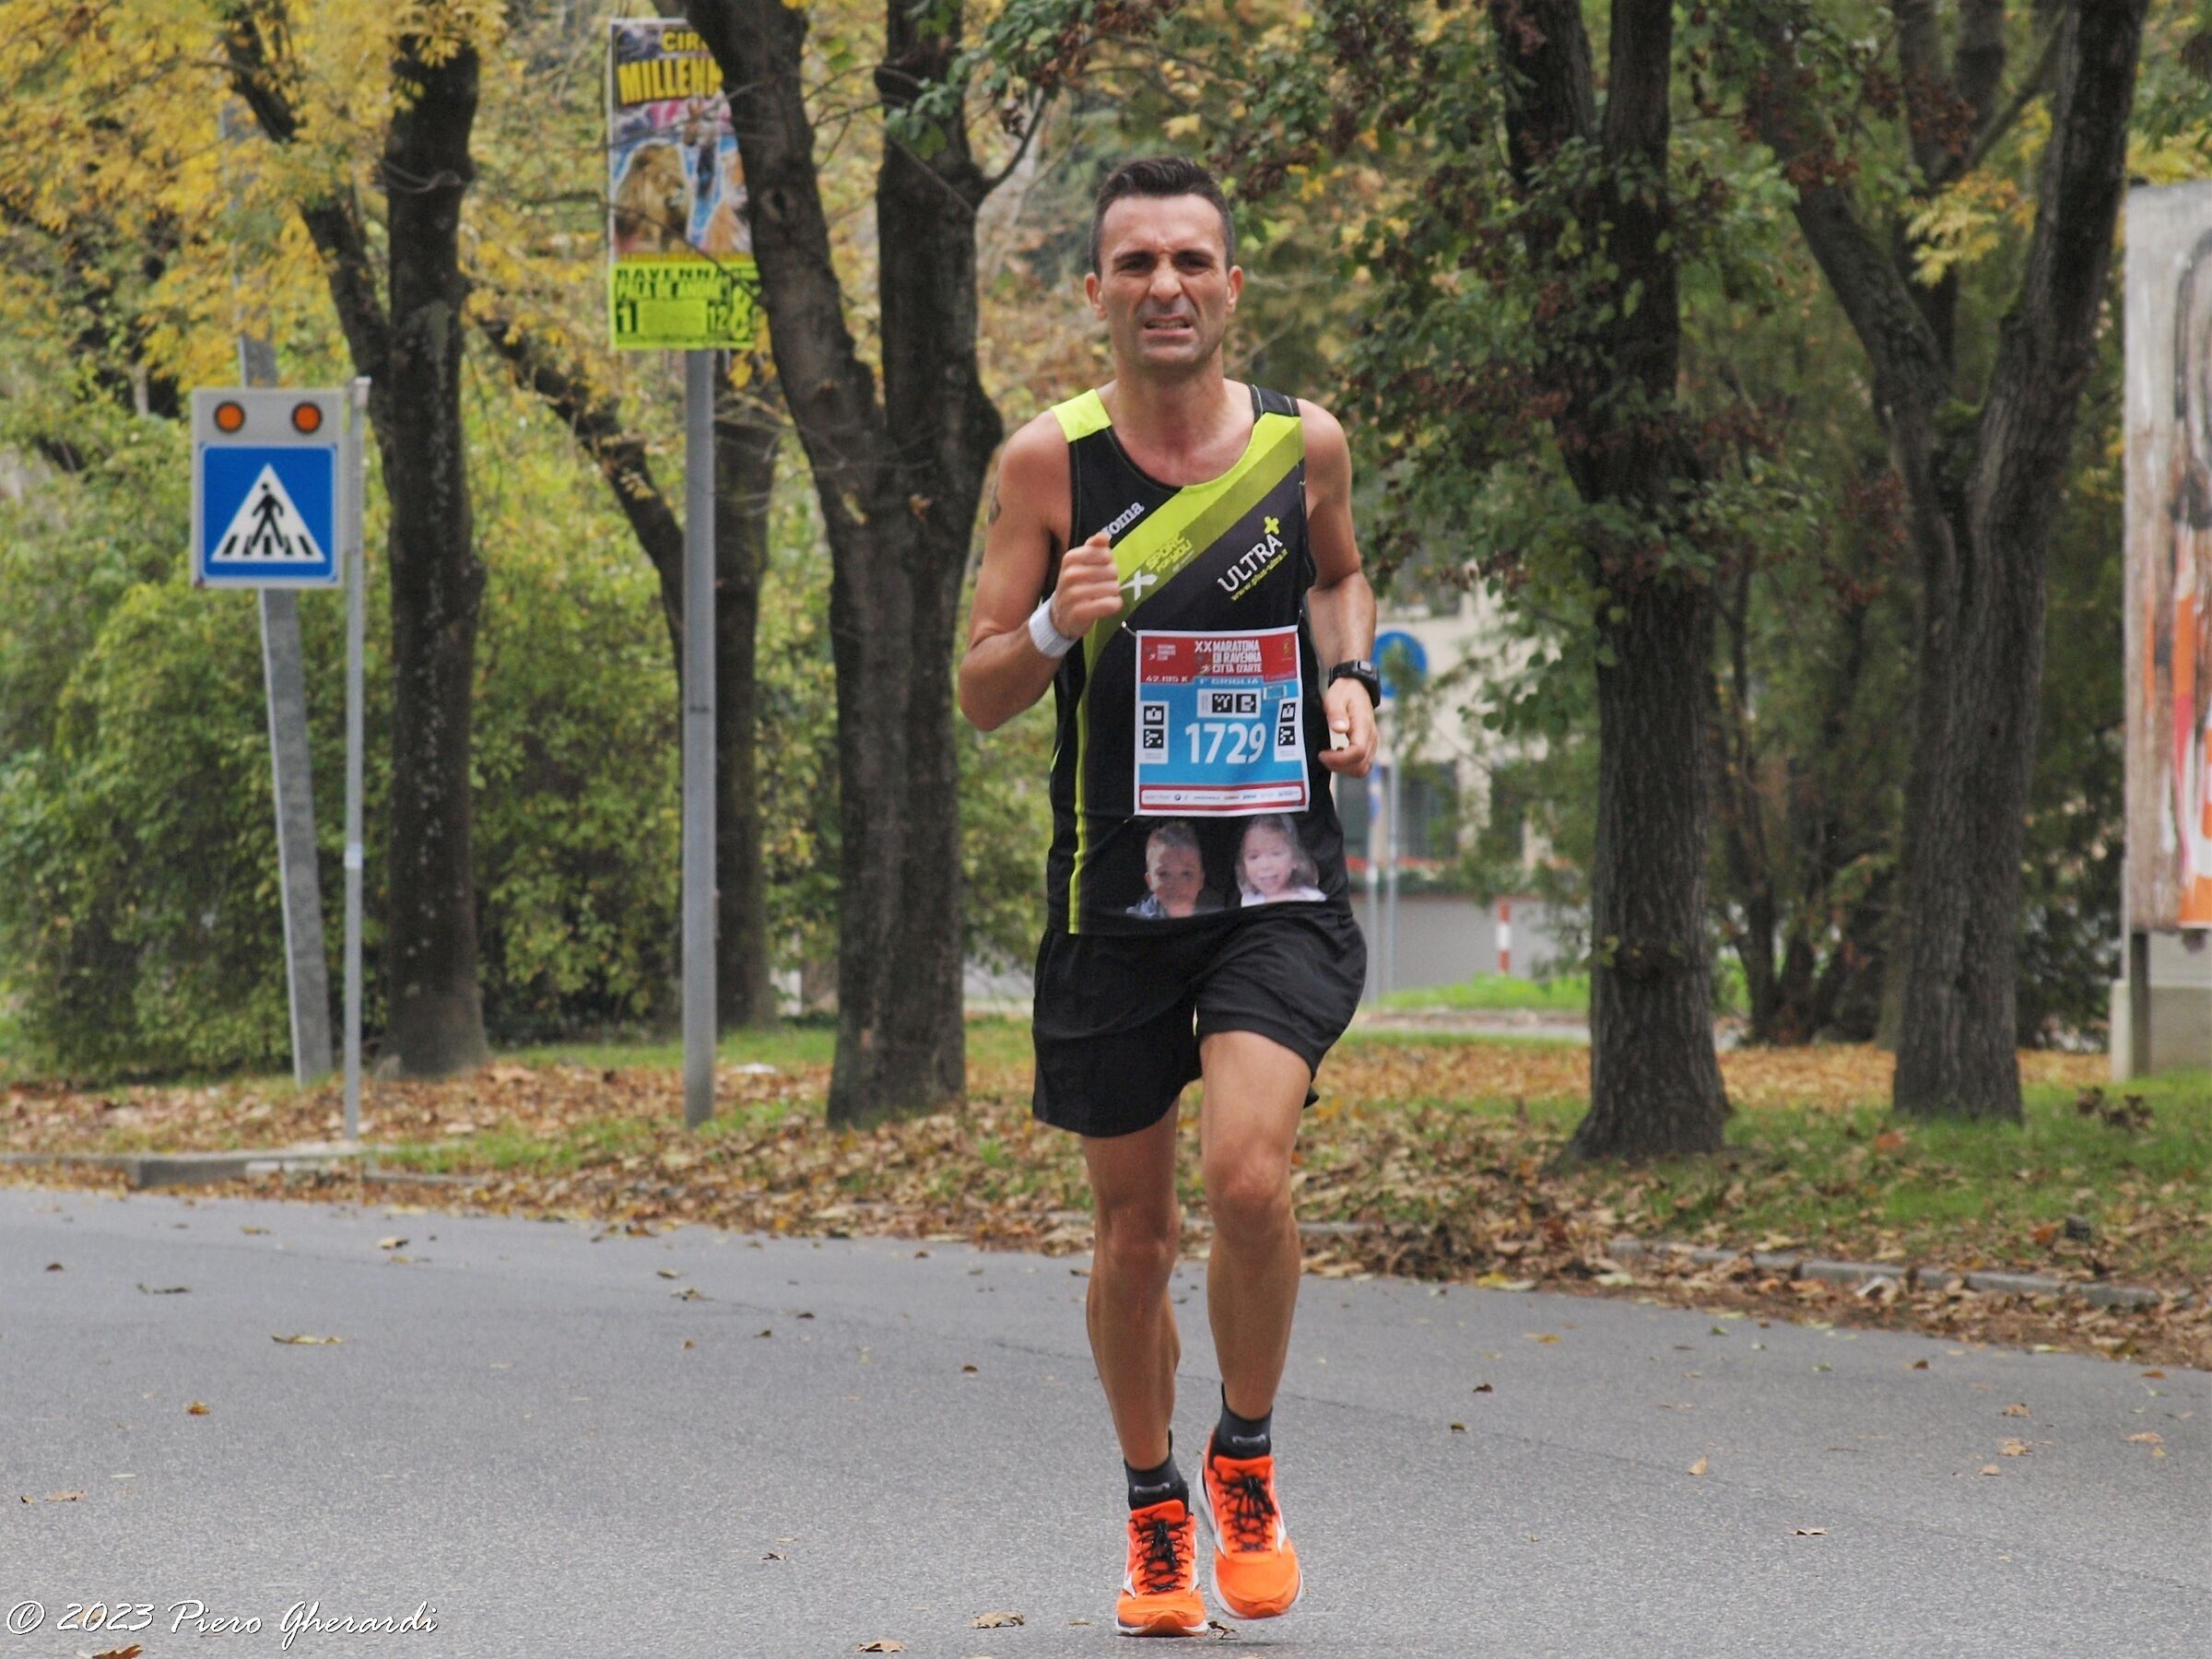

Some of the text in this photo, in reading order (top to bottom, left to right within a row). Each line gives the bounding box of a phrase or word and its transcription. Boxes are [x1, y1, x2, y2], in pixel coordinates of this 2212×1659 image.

[1218, 534, 1283, 592] ULTRA
[1194, 640, 1260, 653] XX MARATONA
[1212, 651, 1263, 664] DI RAVENNA
[1184, 723, 1267, 765] 1729
